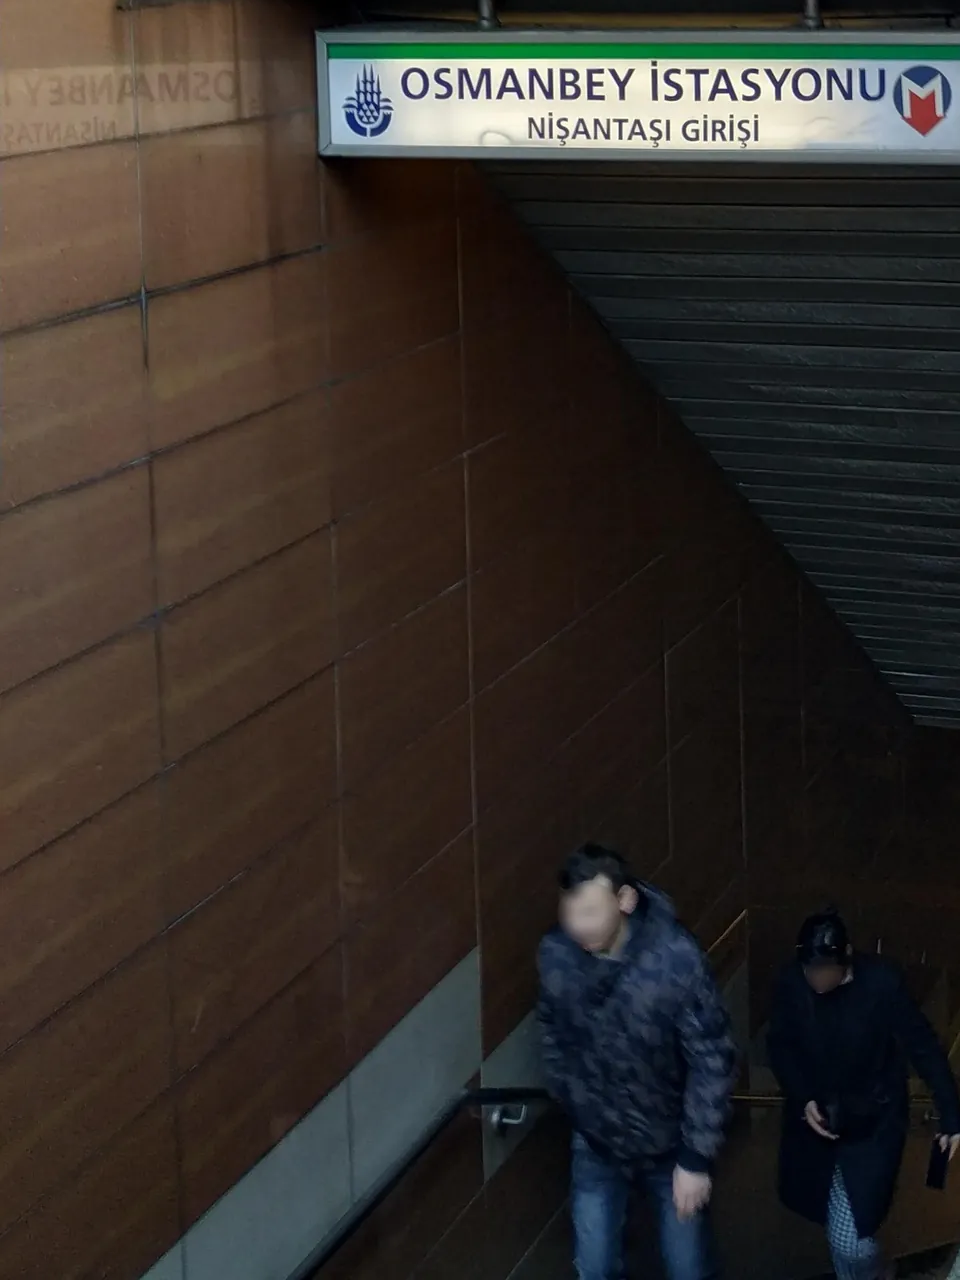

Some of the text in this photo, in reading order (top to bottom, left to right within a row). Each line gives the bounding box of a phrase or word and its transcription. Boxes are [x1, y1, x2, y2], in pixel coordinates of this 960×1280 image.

[400, 60, 886, 103] OSMANBEY İSTASYONU
[527, 111, 760, 149] NİŞANTAŞI GİRİŞİ
